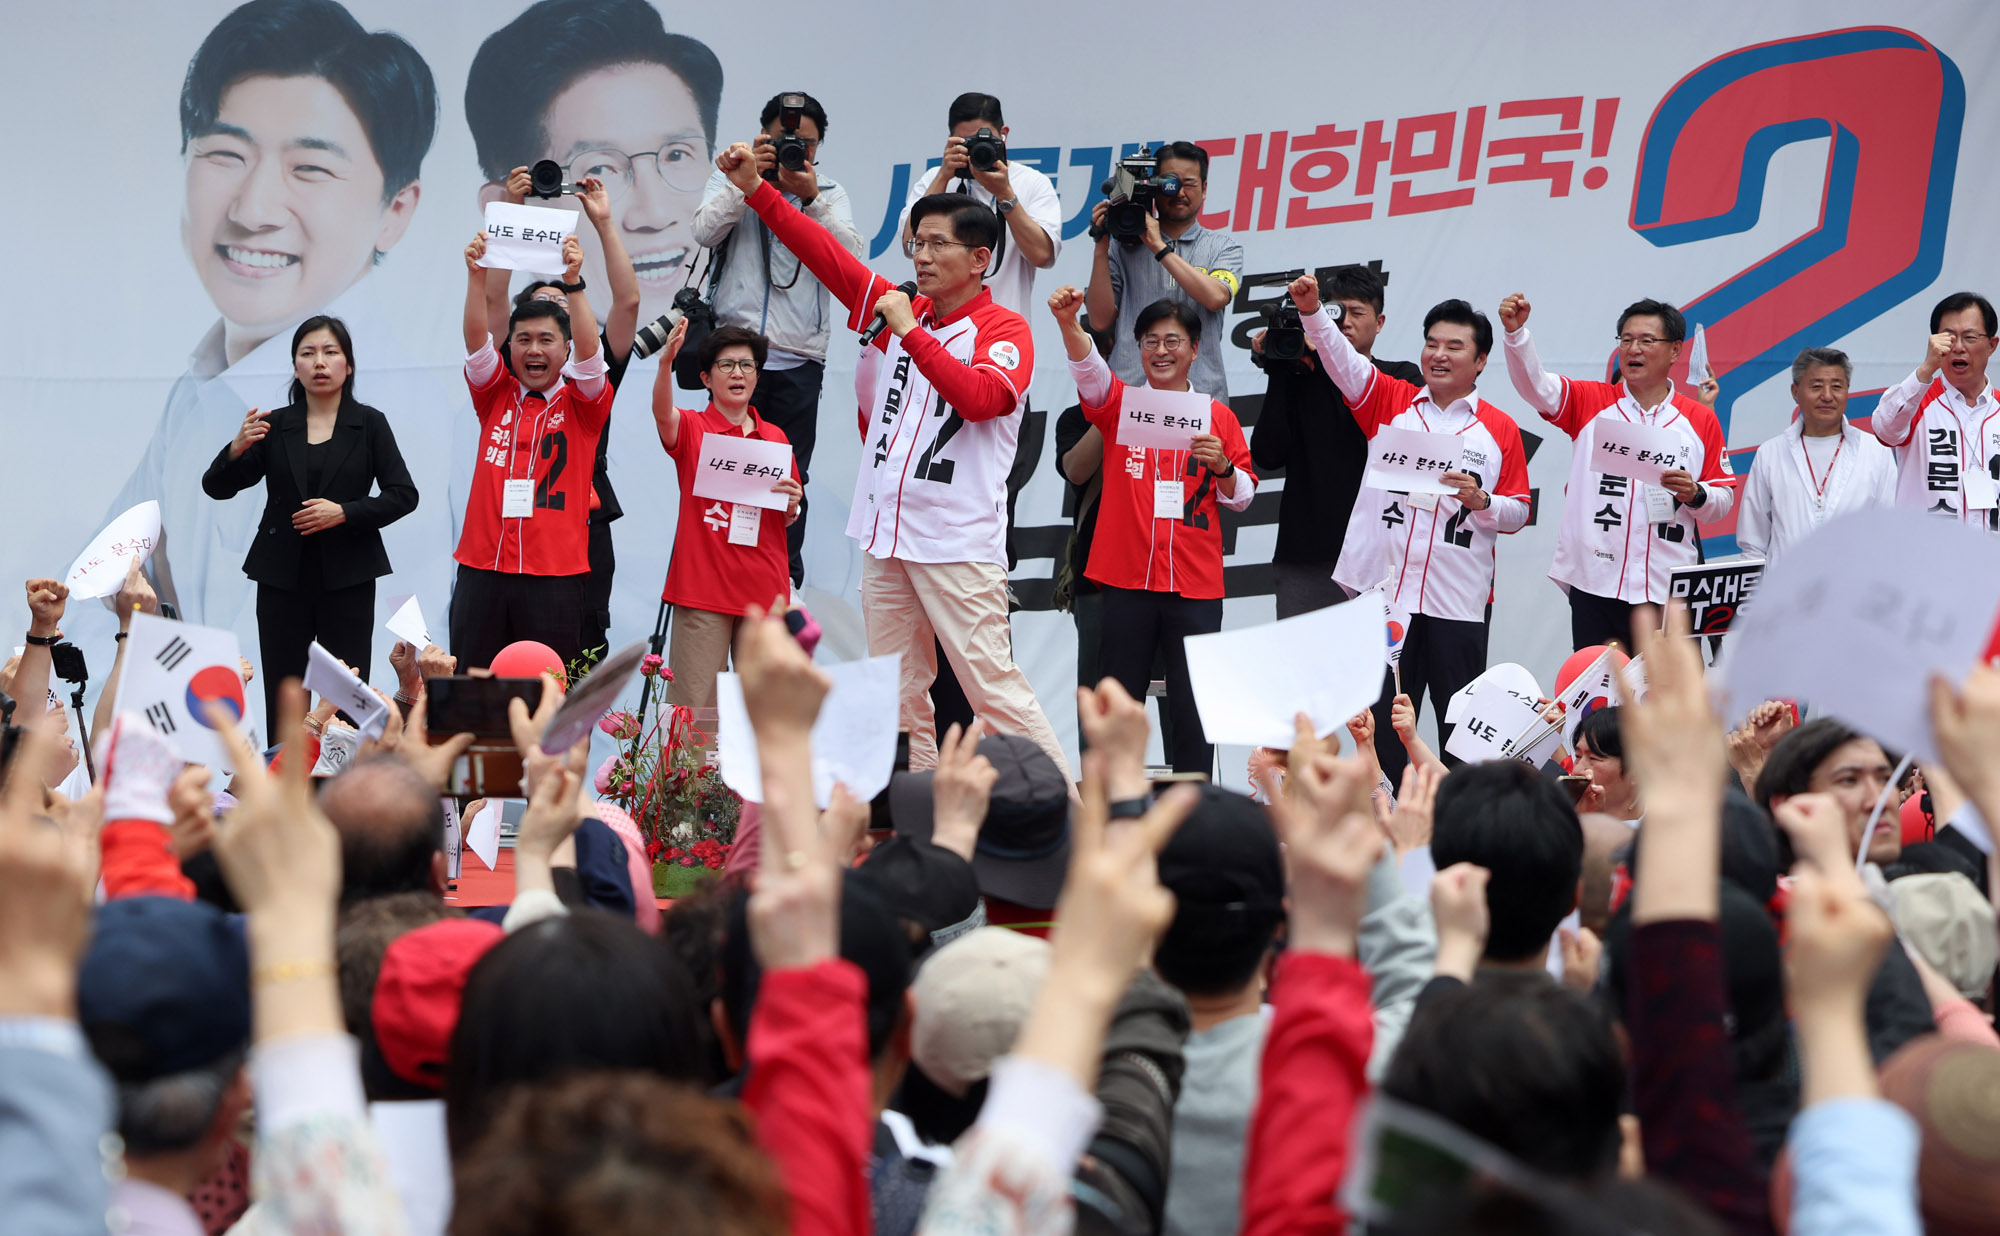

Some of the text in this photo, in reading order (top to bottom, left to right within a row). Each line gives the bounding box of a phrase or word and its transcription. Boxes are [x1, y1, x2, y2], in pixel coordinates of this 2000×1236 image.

[1194, 96, 1621, 232] 대한민국!
[488, 224, 562, 244] 나도 문수다
[1606, 25, 1967, 560] 2
[1129, 411, 1203, 431] 나도 문수다
[1382, 452, 1453, 473] 나도 문수다
[1462, 448, 1488, 461] PEOPLE
[1462, 455, 1486, 467] POWER
[1601, 441, 1630, 456] 나도
[1636, 449, 1676, 468] 문수다
[535, 430, 568, 511] 2
[709, 457, 784, 481] 나도 문수다
[111, 536, 152, 556] 문수다
[1467, 716, 1498, 743] 나도
